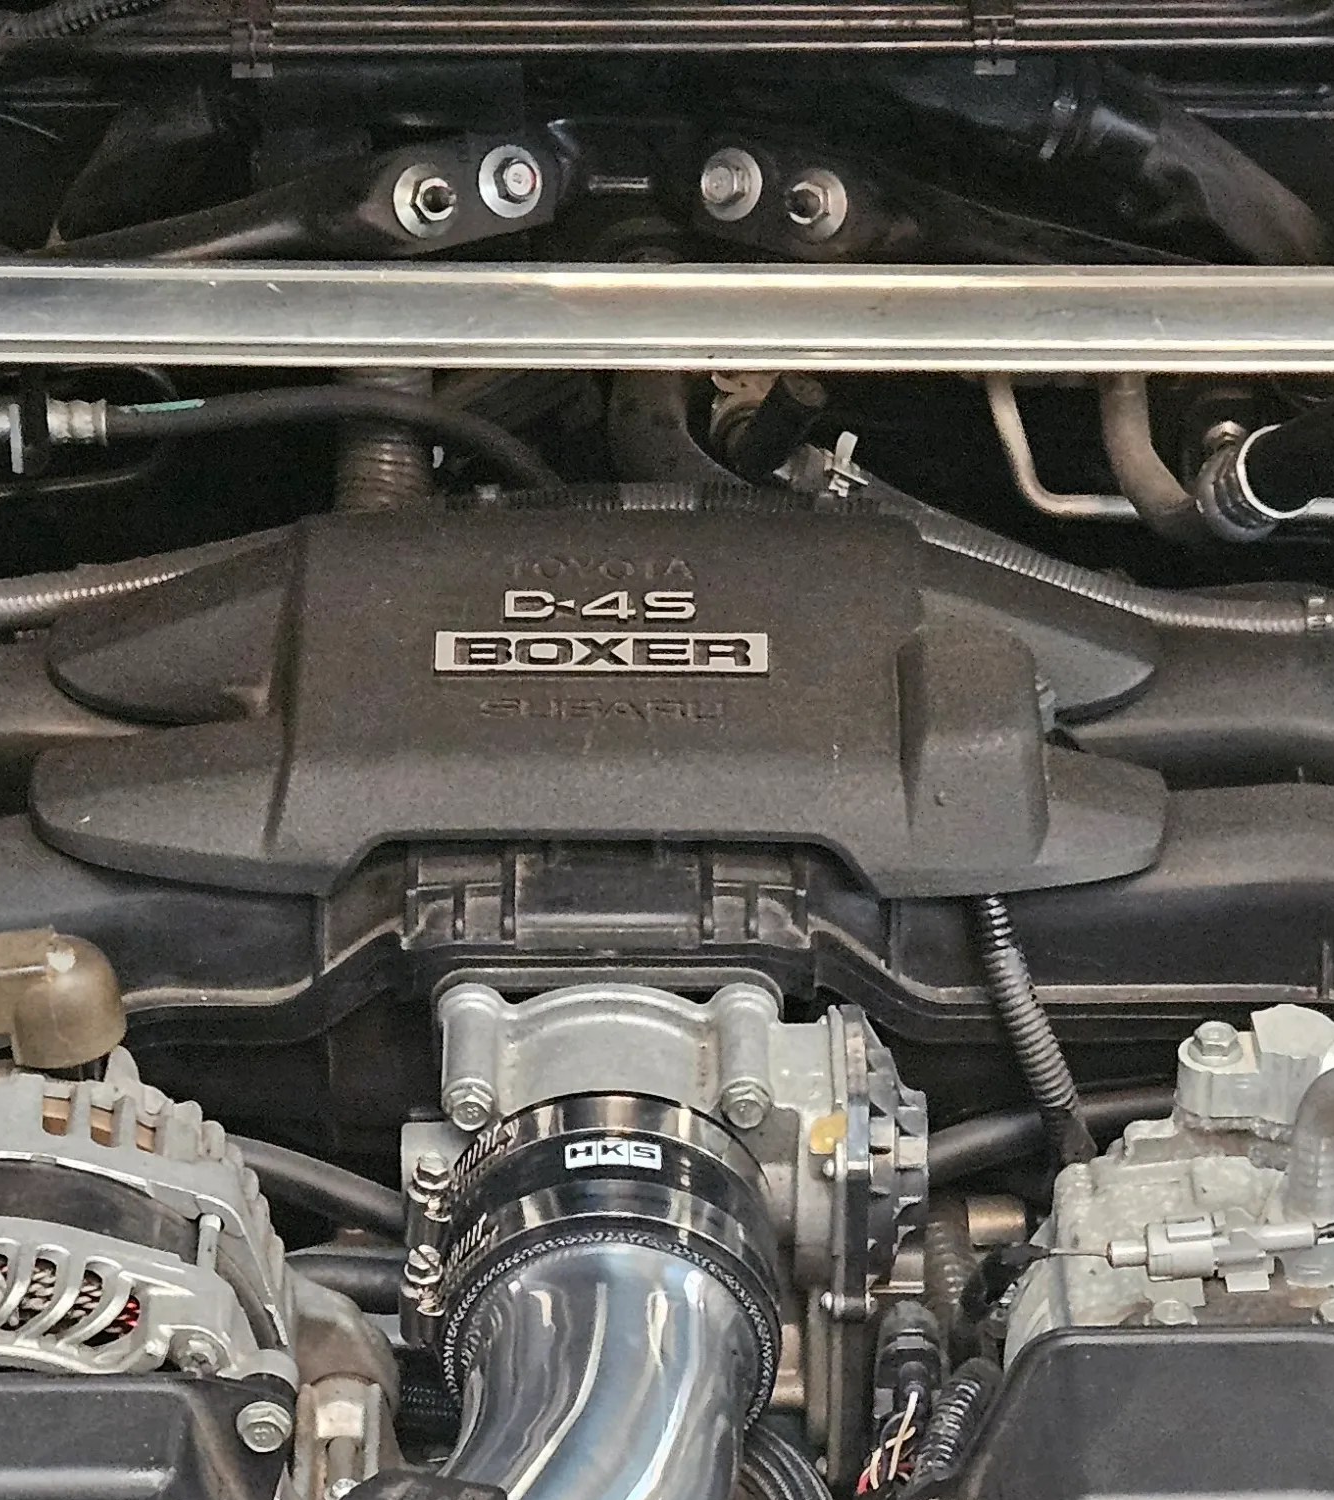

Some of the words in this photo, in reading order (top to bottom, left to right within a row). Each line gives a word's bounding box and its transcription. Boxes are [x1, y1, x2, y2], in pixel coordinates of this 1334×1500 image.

[503, 589, 697, 620] D-4S
[452, 635, 753, 668] BOXER
[568, 1143, 658, 1162] HKS
